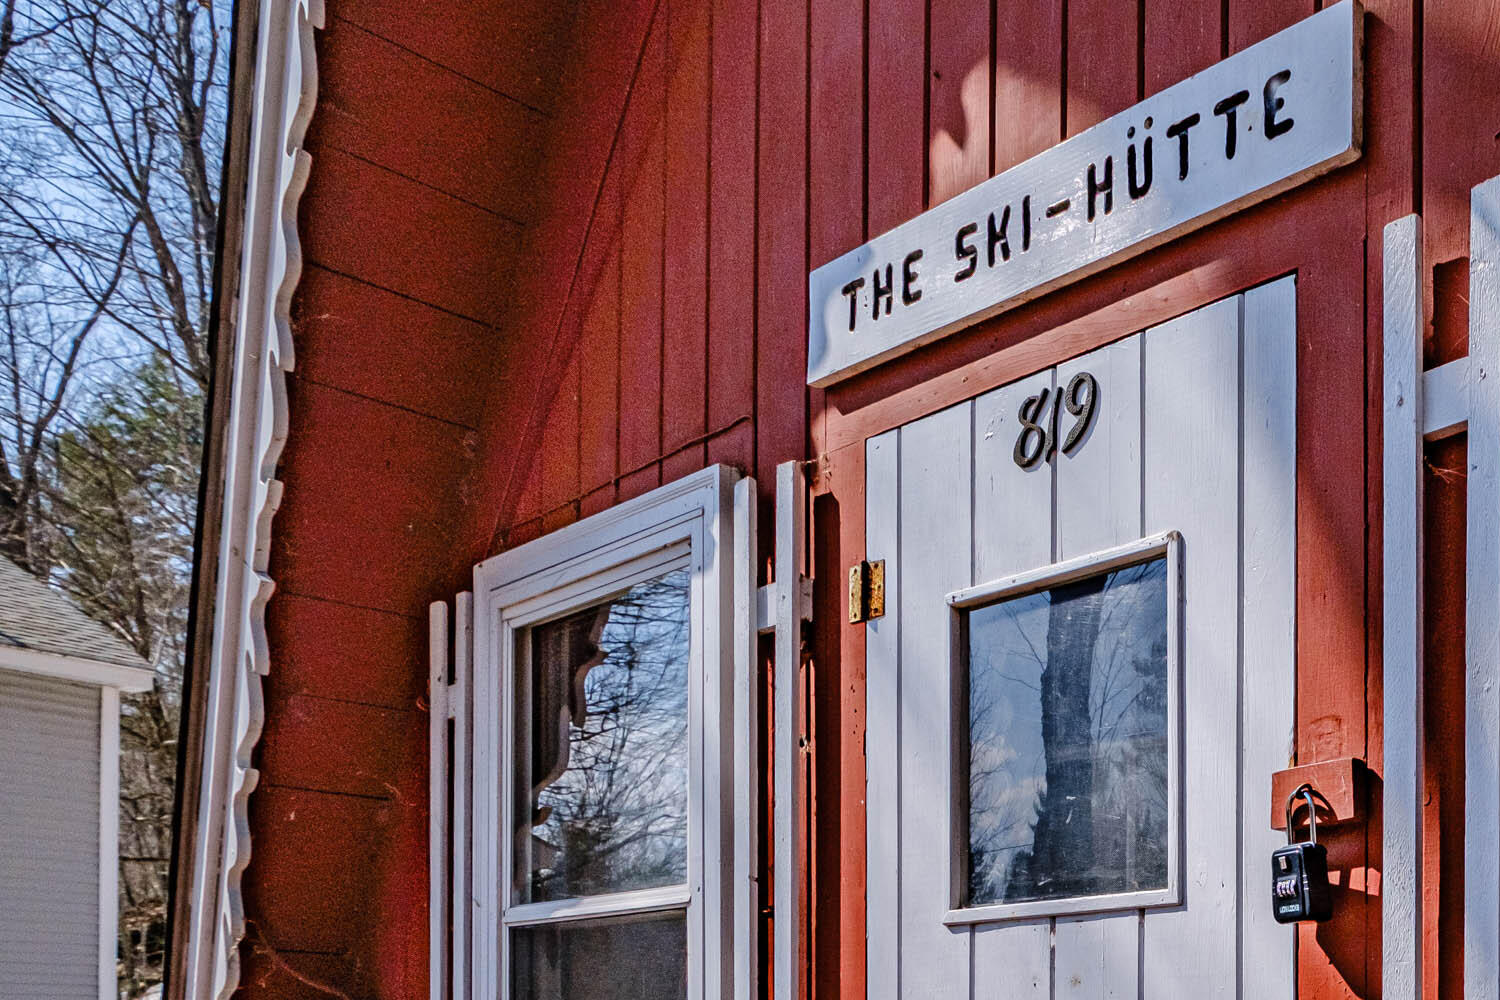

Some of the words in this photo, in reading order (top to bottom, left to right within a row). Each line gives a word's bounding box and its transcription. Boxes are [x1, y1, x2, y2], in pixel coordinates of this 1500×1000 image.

[841, 249, 924, 332] THE
[954, 68, 1296, 283] SKI-HÜTTE
[1013, 371, 1099, 468] 819
